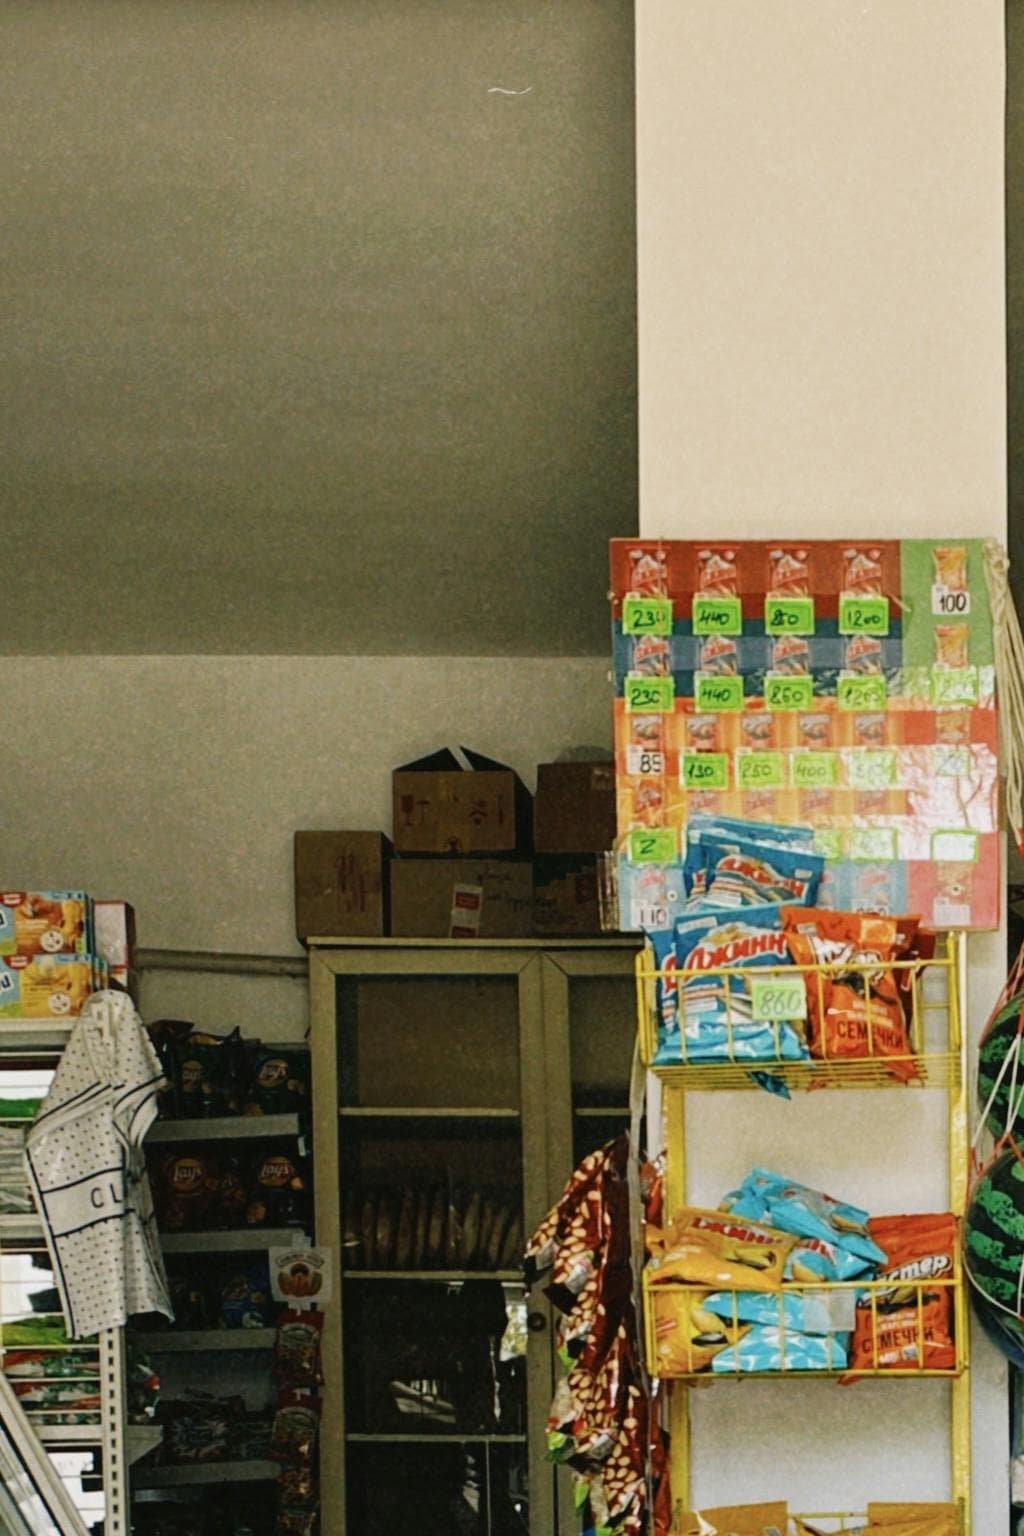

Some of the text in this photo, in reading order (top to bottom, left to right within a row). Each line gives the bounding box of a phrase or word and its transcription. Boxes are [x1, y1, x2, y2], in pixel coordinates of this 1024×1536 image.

[939, 592, 967, 613] 100
[699, 610, 731, 627] 440
[847, 609, 881, 627] 1200
[687, 763, 714, 779] 130
